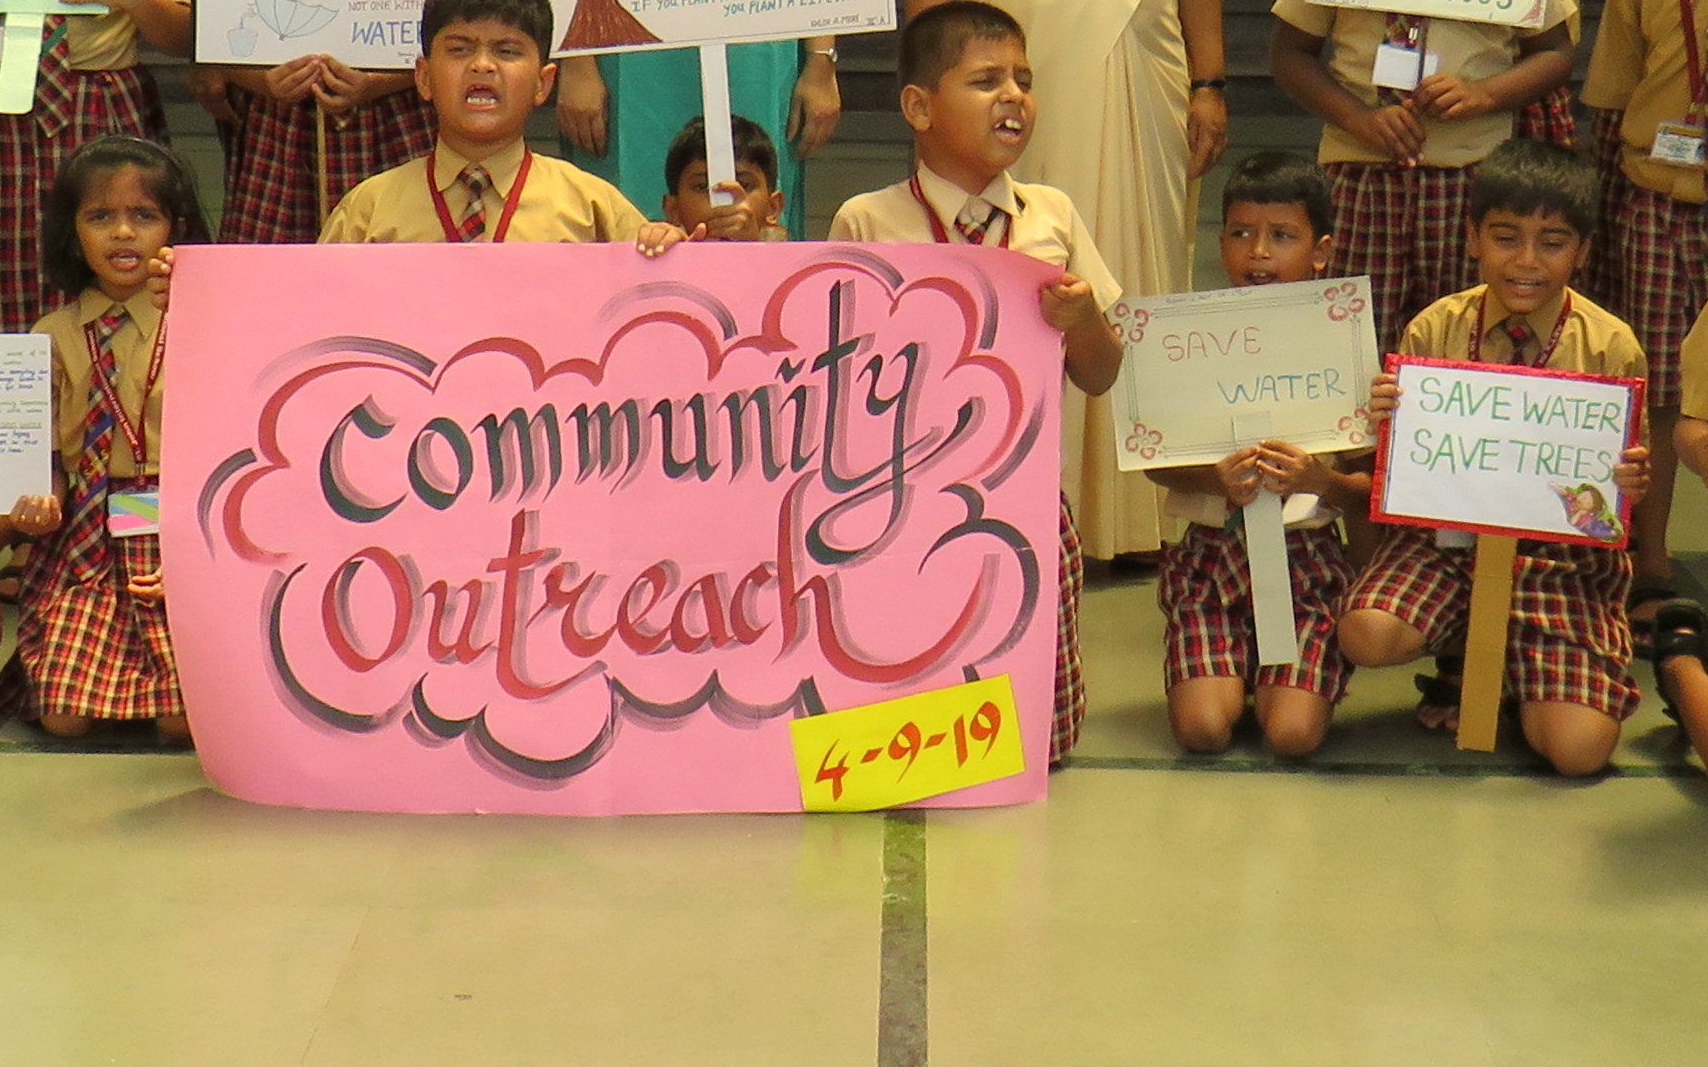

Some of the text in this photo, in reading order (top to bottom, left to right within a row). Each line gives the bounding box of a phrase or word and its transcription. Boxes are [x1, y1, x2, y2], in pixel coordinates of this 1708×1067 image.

[347, 0, 424, 12] NOT ONE WITH
[722, 2, 746, 18] YOU
[1161, 325, 1262, 362] SAVE
[1216, 367, 1347, 405] WATER
[1418, 376, 1623, 434] SAVE WATER
[319, 278, 979, 566] Community
[1409, 427, 1615, 484] SAVE TREES
[320, 472, 989, 700] Outreach
[813, 700, 1004, 803] 4-9-19
